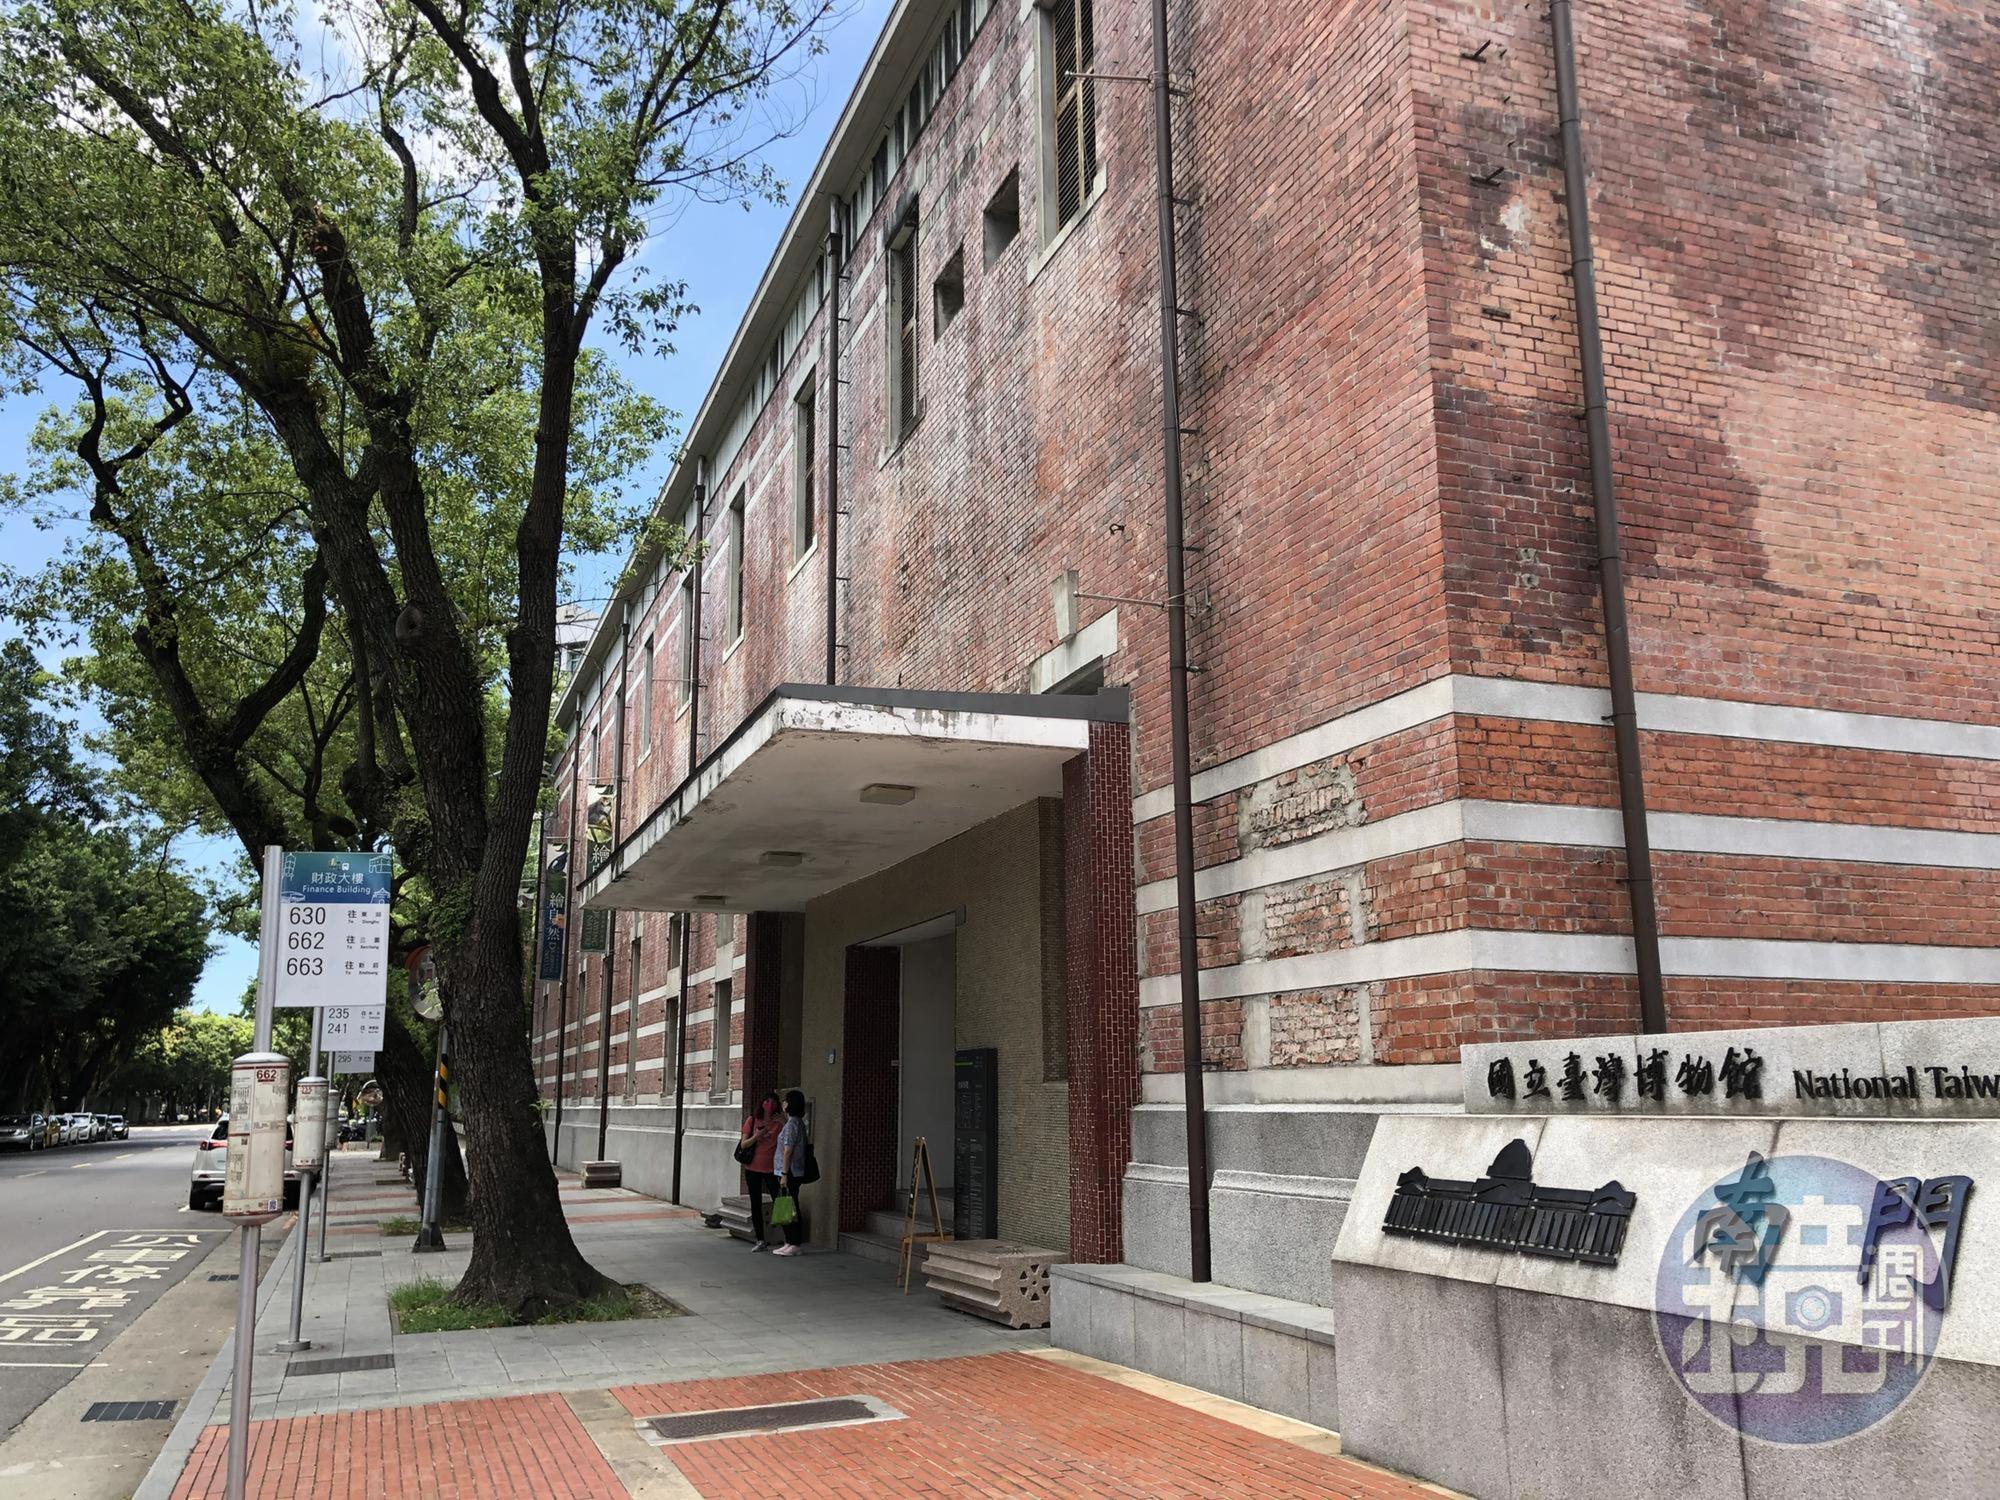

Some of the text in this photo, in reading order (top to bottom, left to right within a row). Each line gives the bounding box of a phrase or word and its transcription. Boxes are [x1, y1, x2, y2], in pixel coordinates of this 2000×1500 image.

[311, 872, 364, 885] 財政大樓
[302, 885, 371, 895] Finance Building
[290, 907, 326, 925] 630
[288, 931, 325, 950] 662
[286, 957, 323, 976] 663
[328, 1007, 350, 1019] 235
[327, 1023, 347, 1034] 241
[256, 1069, 277, 1079] 662
[1487, 1046, 1764, 1102] 國立臺灣博物館
[1792, 1065, 1920, 1100] National
[1692, 1149, 1976, 1312] 南門
